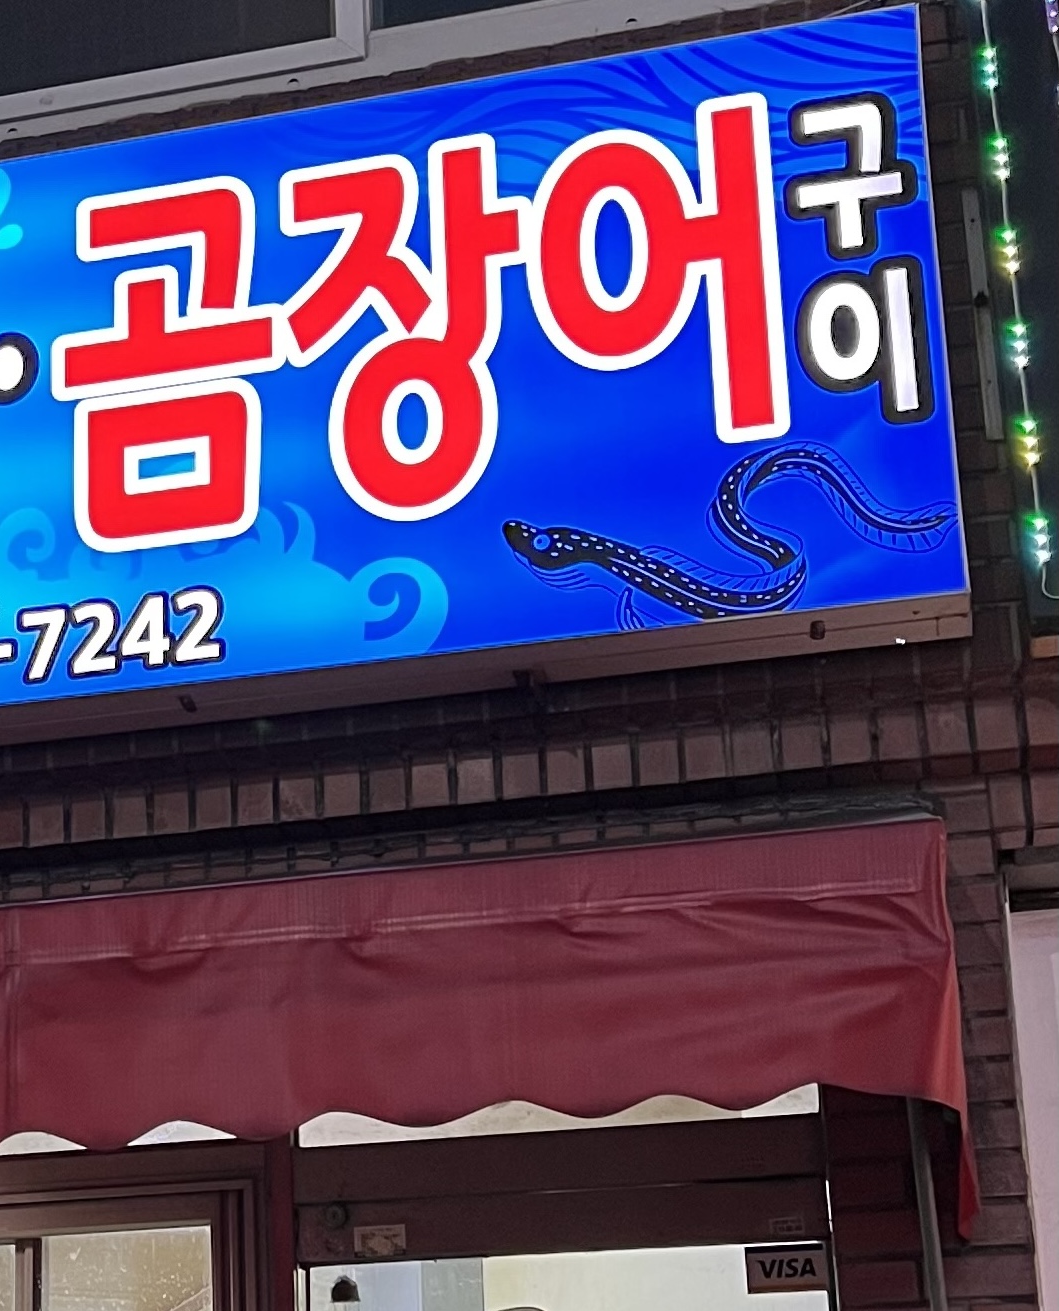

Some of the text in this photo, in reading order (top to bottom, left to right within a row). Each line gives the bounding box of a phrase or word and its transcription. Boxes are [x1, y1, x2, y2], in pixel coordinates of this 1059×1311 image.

[52, 92, 791, 553] 곰장어
[789, 92, 922, 424] 구이
[757, 1257, 817, 1279] VISA
